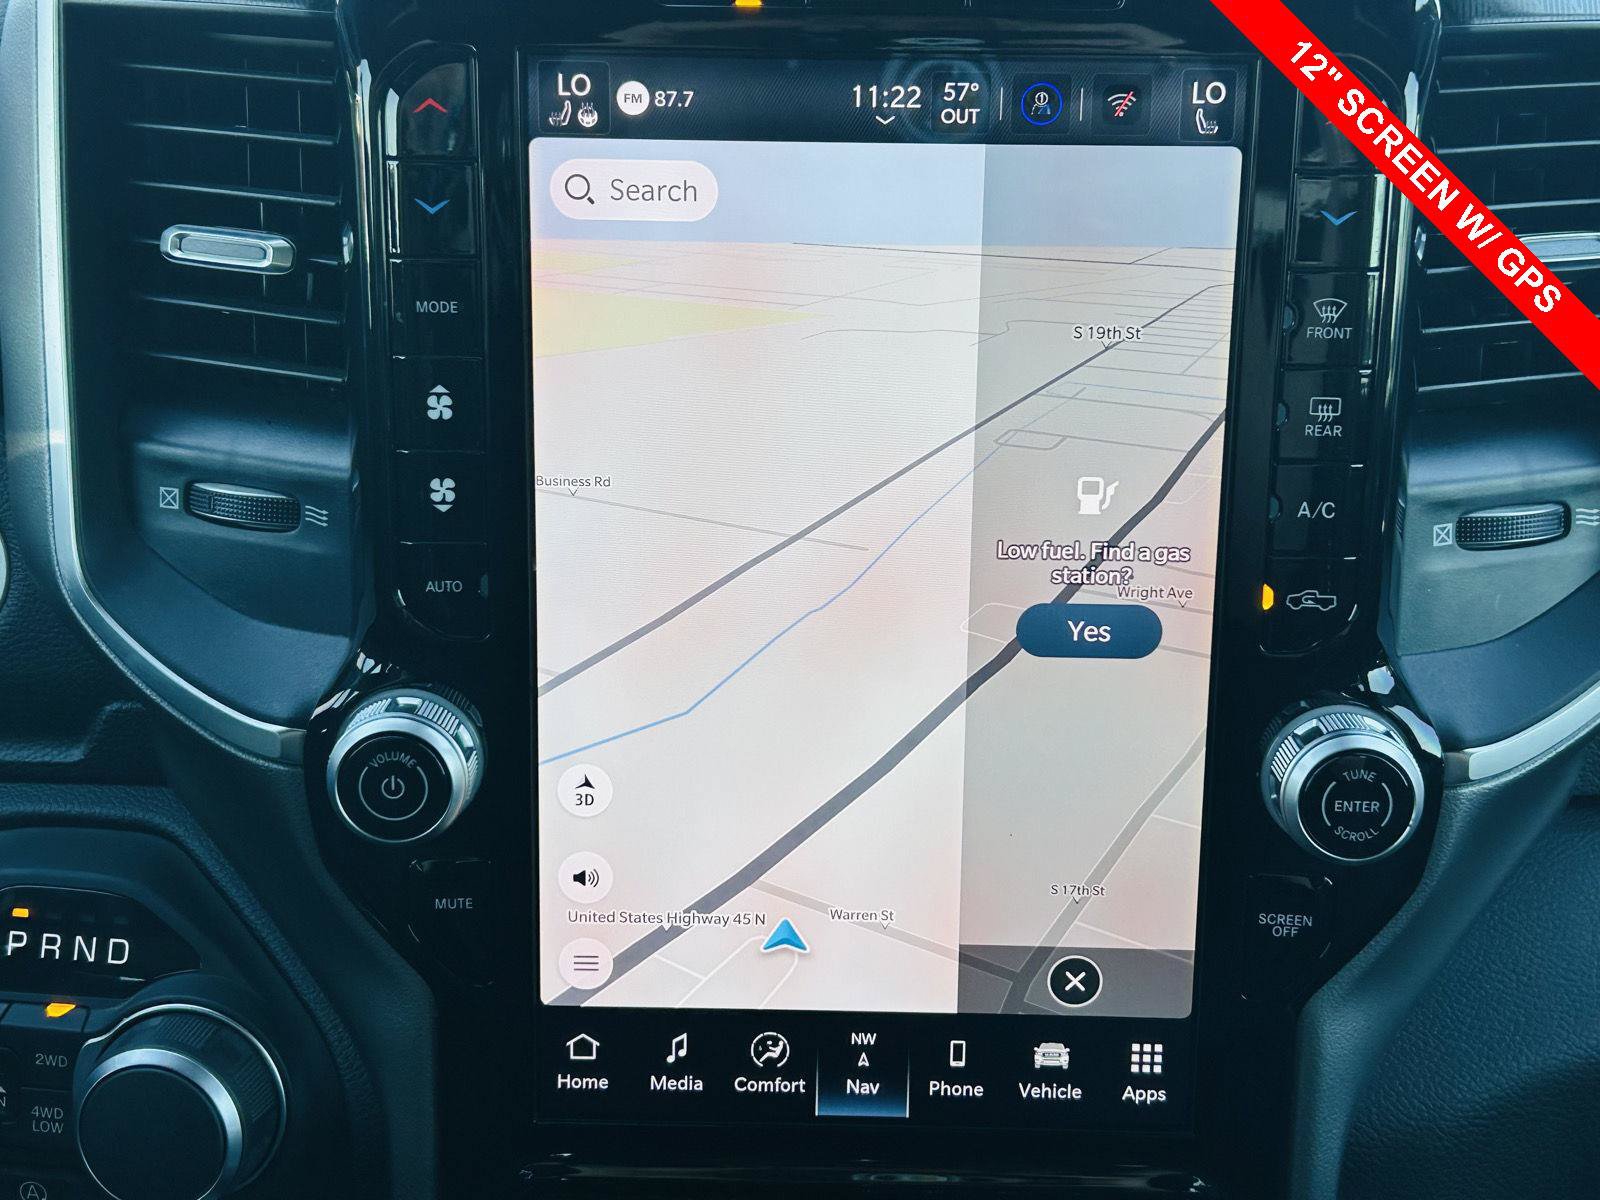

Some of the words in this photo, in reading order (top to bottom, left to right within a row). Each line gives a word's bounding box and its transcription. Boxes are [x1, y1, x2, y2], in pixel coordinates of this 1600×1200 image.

[557, 73, 591, 97] LO
[1191, 81, 1226, 105] LO
[623, 93, 643, 104] FM
[654, 90, 694, 108] 87.7
[851, 85, 922, 109] 11:22
[940, 107, 981, 125] OUT
[609, 178, 698, 203] Search
[415, 300, 459, 315] MODE
[1073, 325, 1083, 340] S
[1088, 325, 1122, 340] 19th
[1125, 326, 1142, 341] St
[1306, 326, 1353, 340] FRONT
[1304, 423, 1343, 438] REAR
[536, 475, 591, 487] Business
[594, 476, 611, 488] Rd
[1297, 501, 1336, 519] A/C
[997, 540, 1038, 560] Low
[1040, 540, 1086, 561] fuel.
[1091, 541, 1135, 562] Find
[1138, 547, 1150, 562] a
[1153, 546, 1191, 566] gas
[1050, 566, 1134, 586] station?
[425, 580, 463, 593] AUTO
[1117, 585, 1164, 600] Wright
[1168, 587, 1193, 599] Ave
[1068, 620, 1112, 643] Yes
[369, 752, 418, 769] VOLUME
[1342, 769, 1377, 784] TUNE
[575, 793, 595, 807] 3D
[1334, 800, 1380, 814] ENTER
[1334, 825, 1380, 843] SCROLL
[1050, 884, 1059, 896] S
[1063, 884, 1090, 897] 17th
[1091, 885, 1106, 897] St
[434, 897, 473, 910] MUTE
[568, 910, 616, 924] United
[619, 911, 664, 925] States
[667, 911, 730, 928] Highway
[733, 913, 751, 925] 45
[755, 913, 766, 926] N
[830, 908, 877, 921] Warren
[880, 910, 895, 923] St
[1258, 913, 1313, 928] SCREEN
[1272, 926, 1299, 938] OFF
[850, 1032, 877, 1046] NW
[34, 1053, 69, 1068] 2WD
[557, 1073, 610, 1090] Home
[650, 1075, 704, 1092] Media
[734, 1076, 807, 1094] Comfort
[846, 1079, 880, 1095] Nav
[928, 1080, 985, 1098] Phone
[1019, 1082, 1083, 1101] Vehicle
[1121, 1085, 1168, 1105] Apps
[31, 1105, 65, 1120] 4WD
[32, 1120, 65, 1134] LOW
